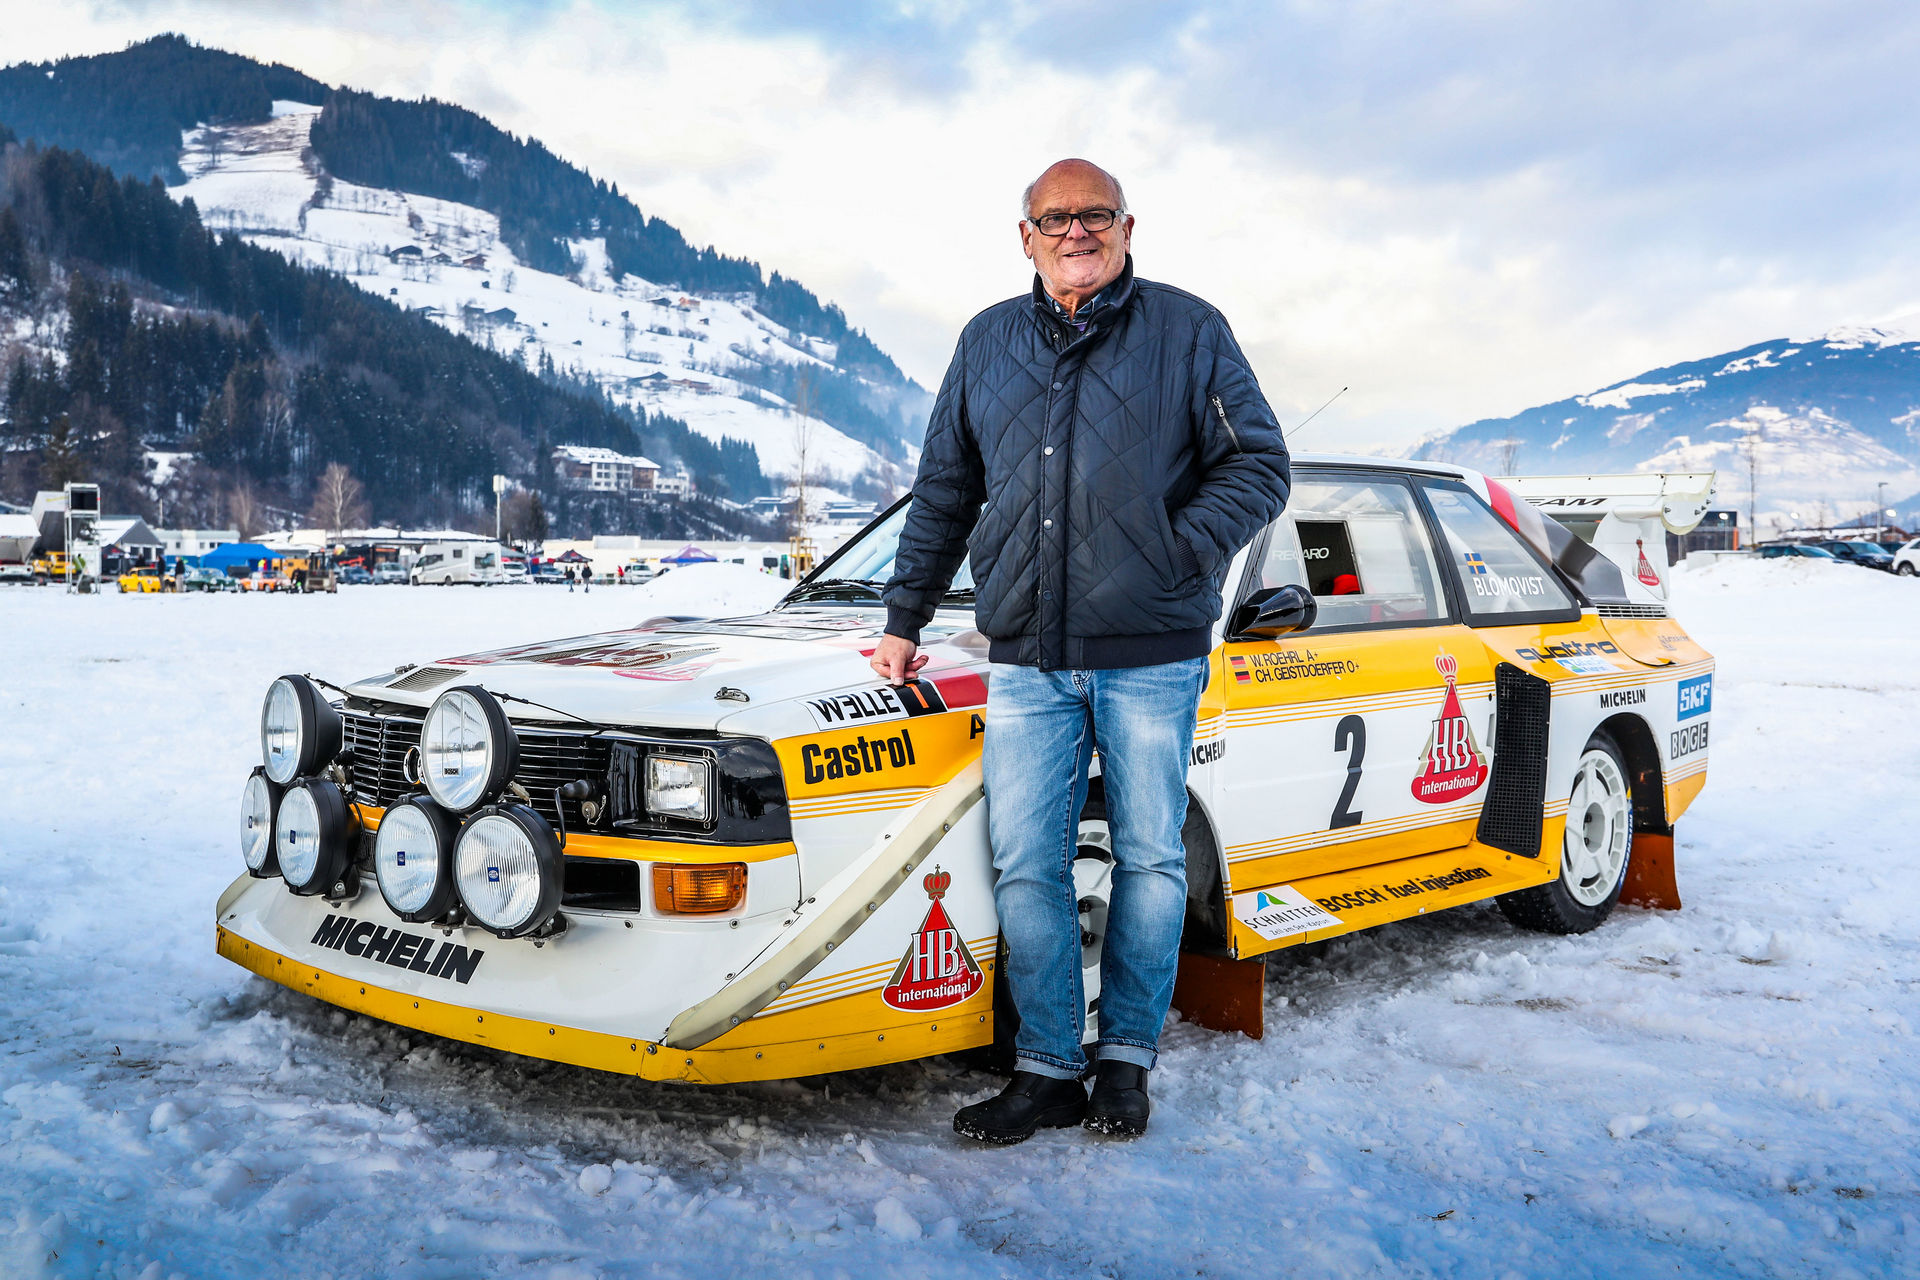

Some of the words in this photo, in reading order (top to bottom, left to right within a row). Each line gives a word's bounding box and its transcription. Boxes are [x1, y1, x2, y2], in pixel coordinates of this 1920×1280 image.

[1524, 497, 1608, 507] EAM
[1472, 576, 1545, 598] BLOMQVIST
[1249, 654, 1264, 668] W.
[1263, 651, 1304, 667] ROEHRL
[1515, 640, 1618, 663] quattro
[1255, 668, 1274, 683] CH.
[1274, 661, 1346, 682] GEISTDOERFER
[1599, 688, 1647, 709] MICHELIN
[1679, 681, 1711, 713] SKF
[1189, 738, 1226, 767] ICHELIN
[1432, 716, 1472, 775] HB
[1671, 722, 1709, 760] BOGE
[801, 728, 916, 785] Castrol
[1329, 714, 1367, 831] 2
[1420, 771, 1479, 796] international
[1315, 888, 1389, 914] BOSCH
[1382, 879, 1425, 899] fuel
[1416, 866, 1493, 891] injection
[1244, 905, 1327, 929] SCHMITTEN
[310, 913, 485, 985] MICHELIN
[911, 928, 960, 983] HB
[897, 978, 971, 1003] international
